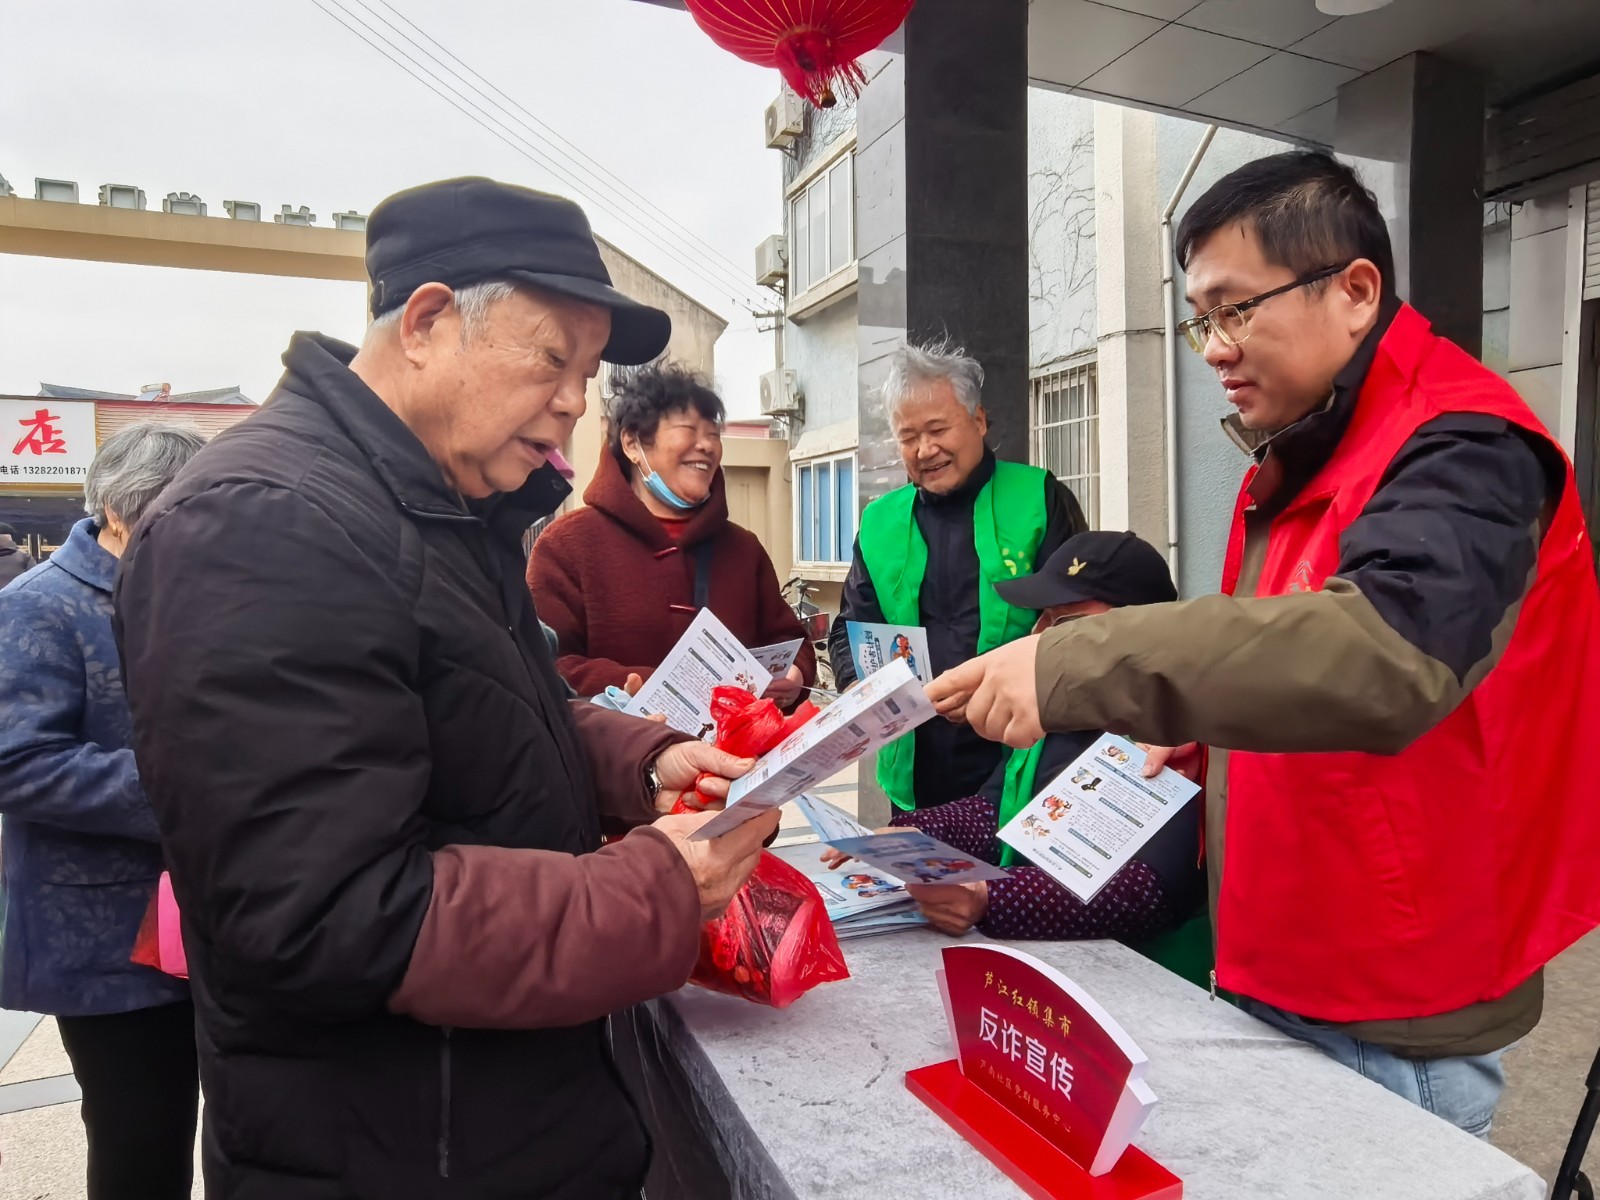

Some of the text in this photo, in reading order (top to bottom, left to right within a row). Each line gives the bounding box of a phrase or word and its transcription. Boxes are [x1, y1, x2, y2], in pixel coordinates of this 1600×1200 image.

[12, 408, 67, 456] 店
[0, 465, 87, 475] 电话 13282201871
[984, 971, 1072, 1038] 芦江红领集市
[979, 1006, 1074, 1102] 反诈宣传
